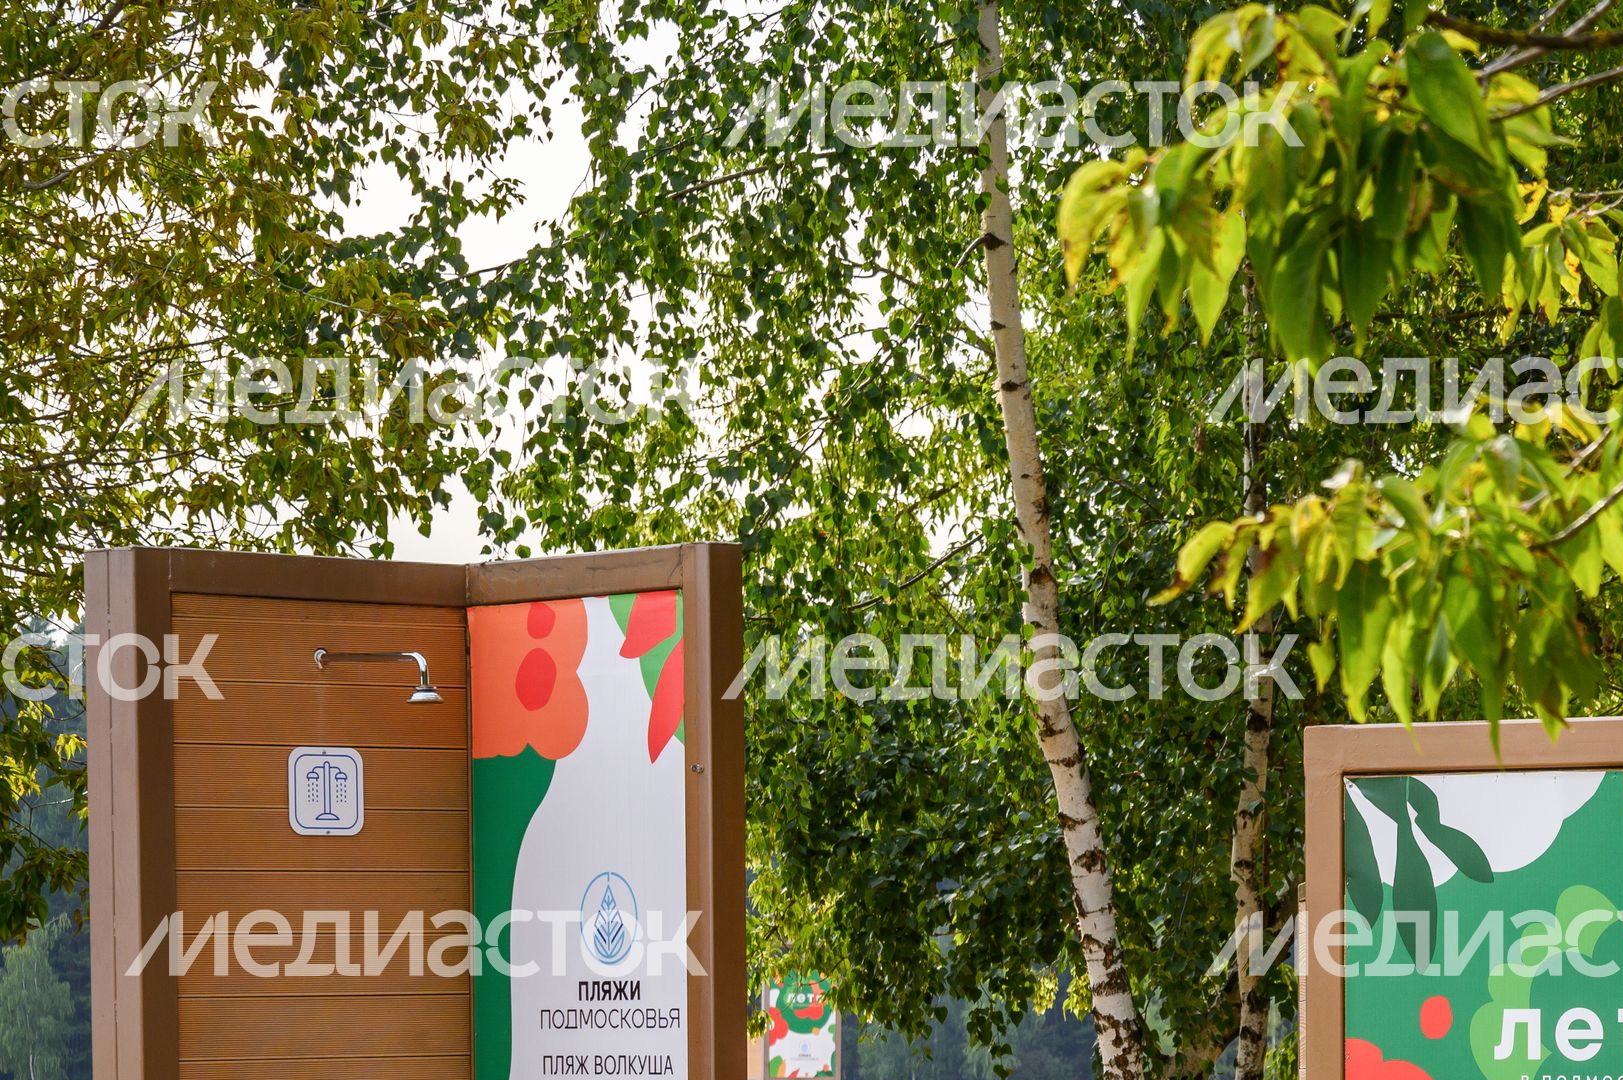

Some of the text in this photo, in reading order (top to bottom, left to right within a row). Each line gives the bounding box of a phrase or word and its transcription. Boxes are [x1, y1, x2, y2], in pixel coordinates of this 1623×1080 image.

[578, 980, 641, 1001] ПЛЯЖИ
[540, 1008, 680, 1029] ПОДМОСКОВЬЯ
[543, 1054, 673, 1076] ПЛЯЖ ВОЛКУША
